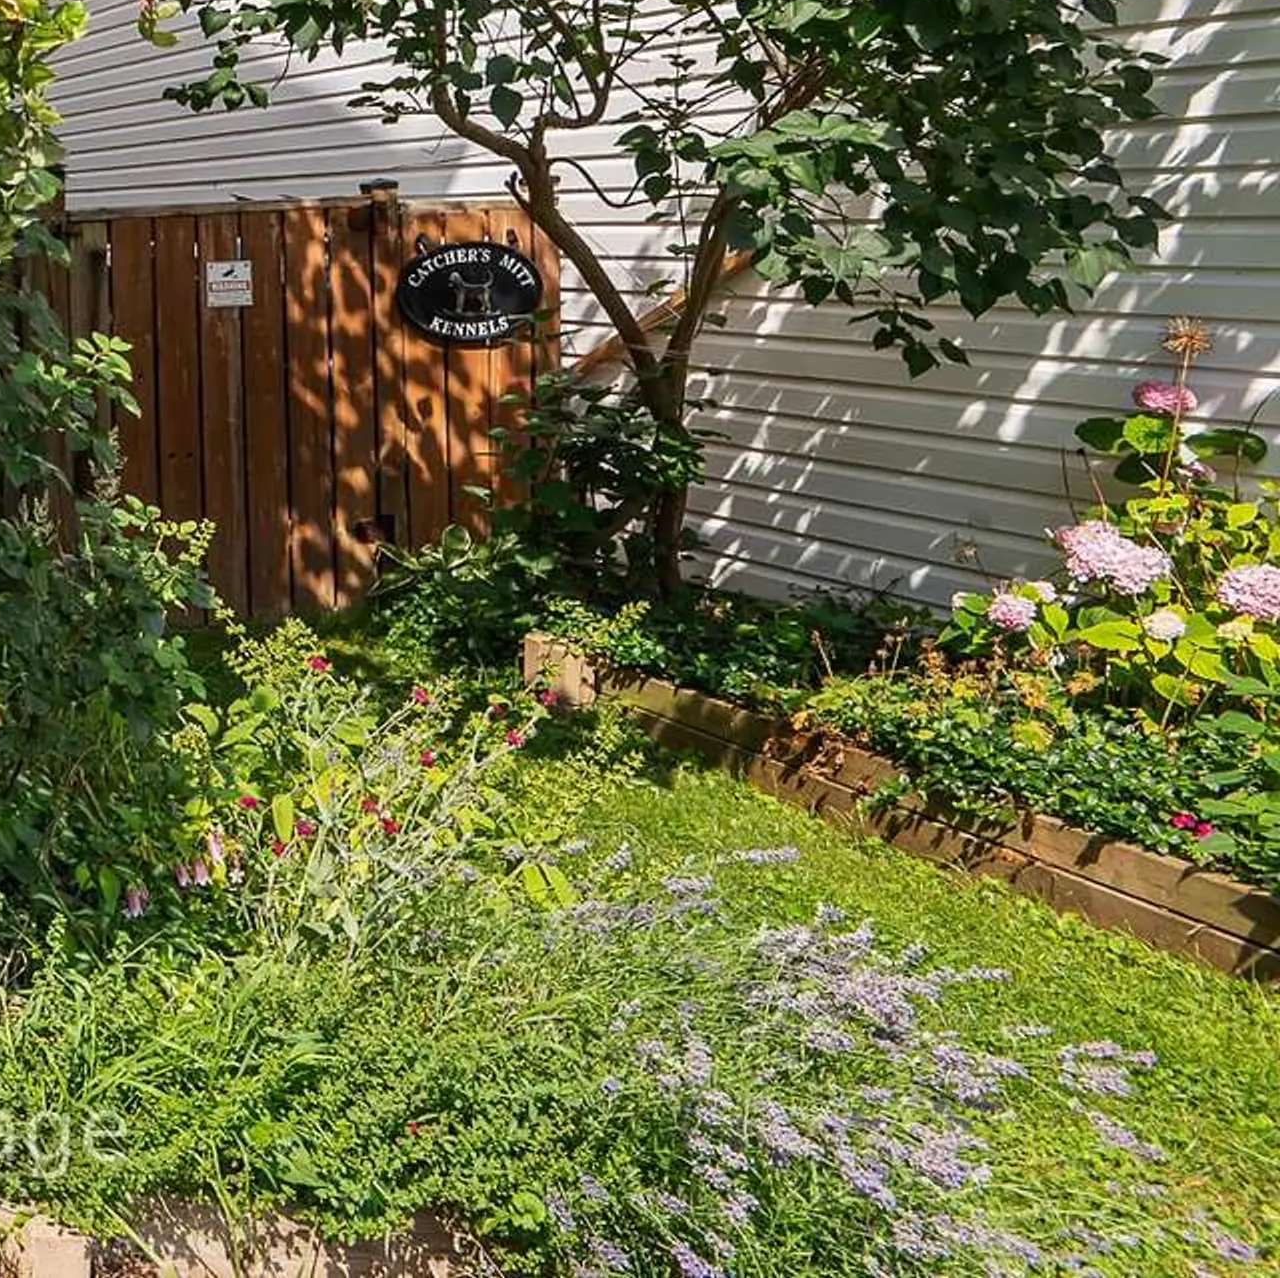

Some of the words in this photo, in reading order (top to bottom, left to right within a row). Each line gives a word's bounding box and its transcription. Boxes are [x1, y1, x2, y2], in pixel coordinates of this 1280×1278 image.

[407, 248, 491, 288] CATCHER'S
[498, 254, 536, 287] MITT
[429, 316, 510, 336] KENNELS
